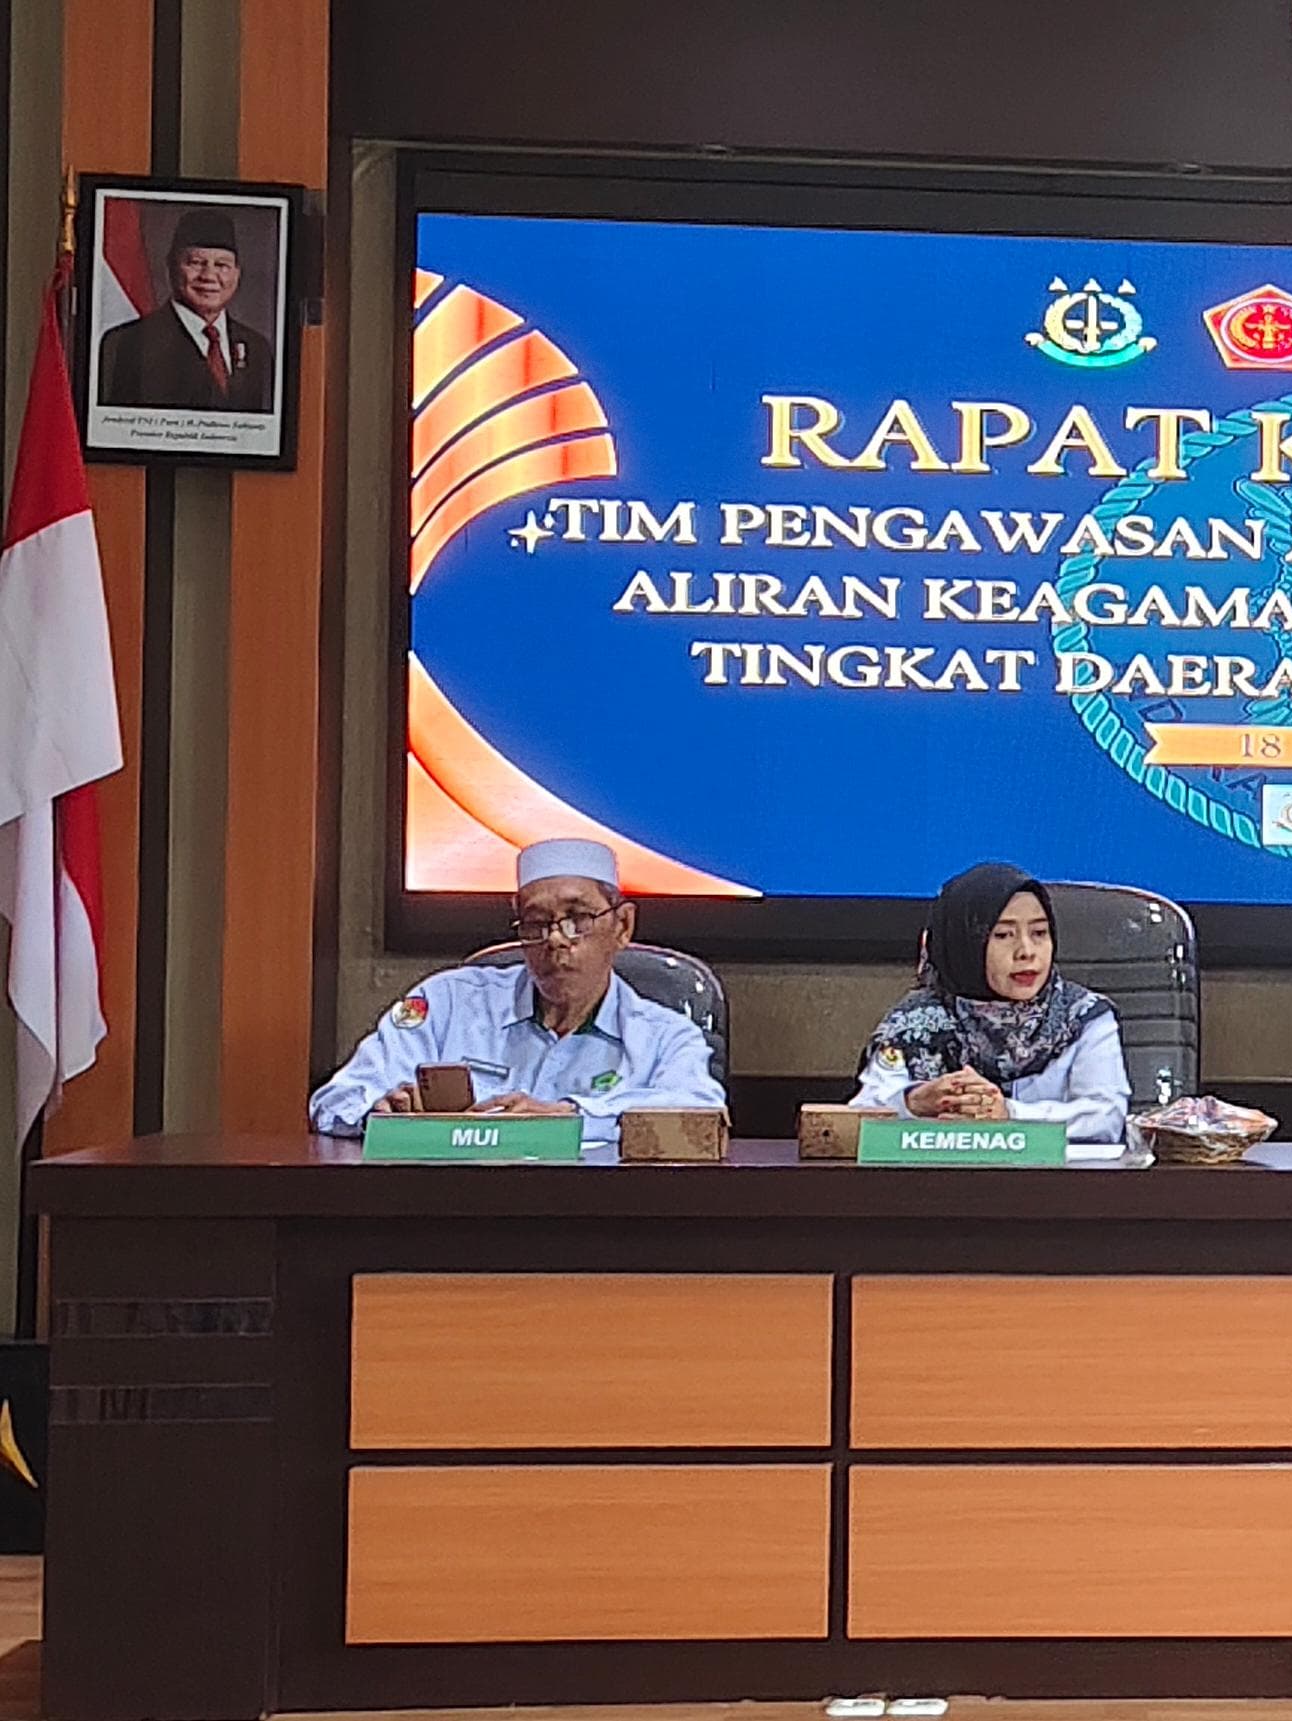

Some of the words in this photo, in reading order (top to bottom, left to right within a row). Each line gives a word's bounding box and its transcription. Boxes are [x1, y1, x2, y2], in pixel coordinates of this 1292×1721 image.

[761, 395, 1211, 479] RAPAT
[549, 497, 697, 545] TIM
[720, 503, 1265, 561] PENGAWASAN
[613, 571, 901, 619] ALIRAN
[691, 642, 1036, 691] TINGKAT
[1241, 733, 1282, 759] 18
[451, 1128, 499, 1147] MUI
[901, 1130, 1026, 1152] KEMENAG
